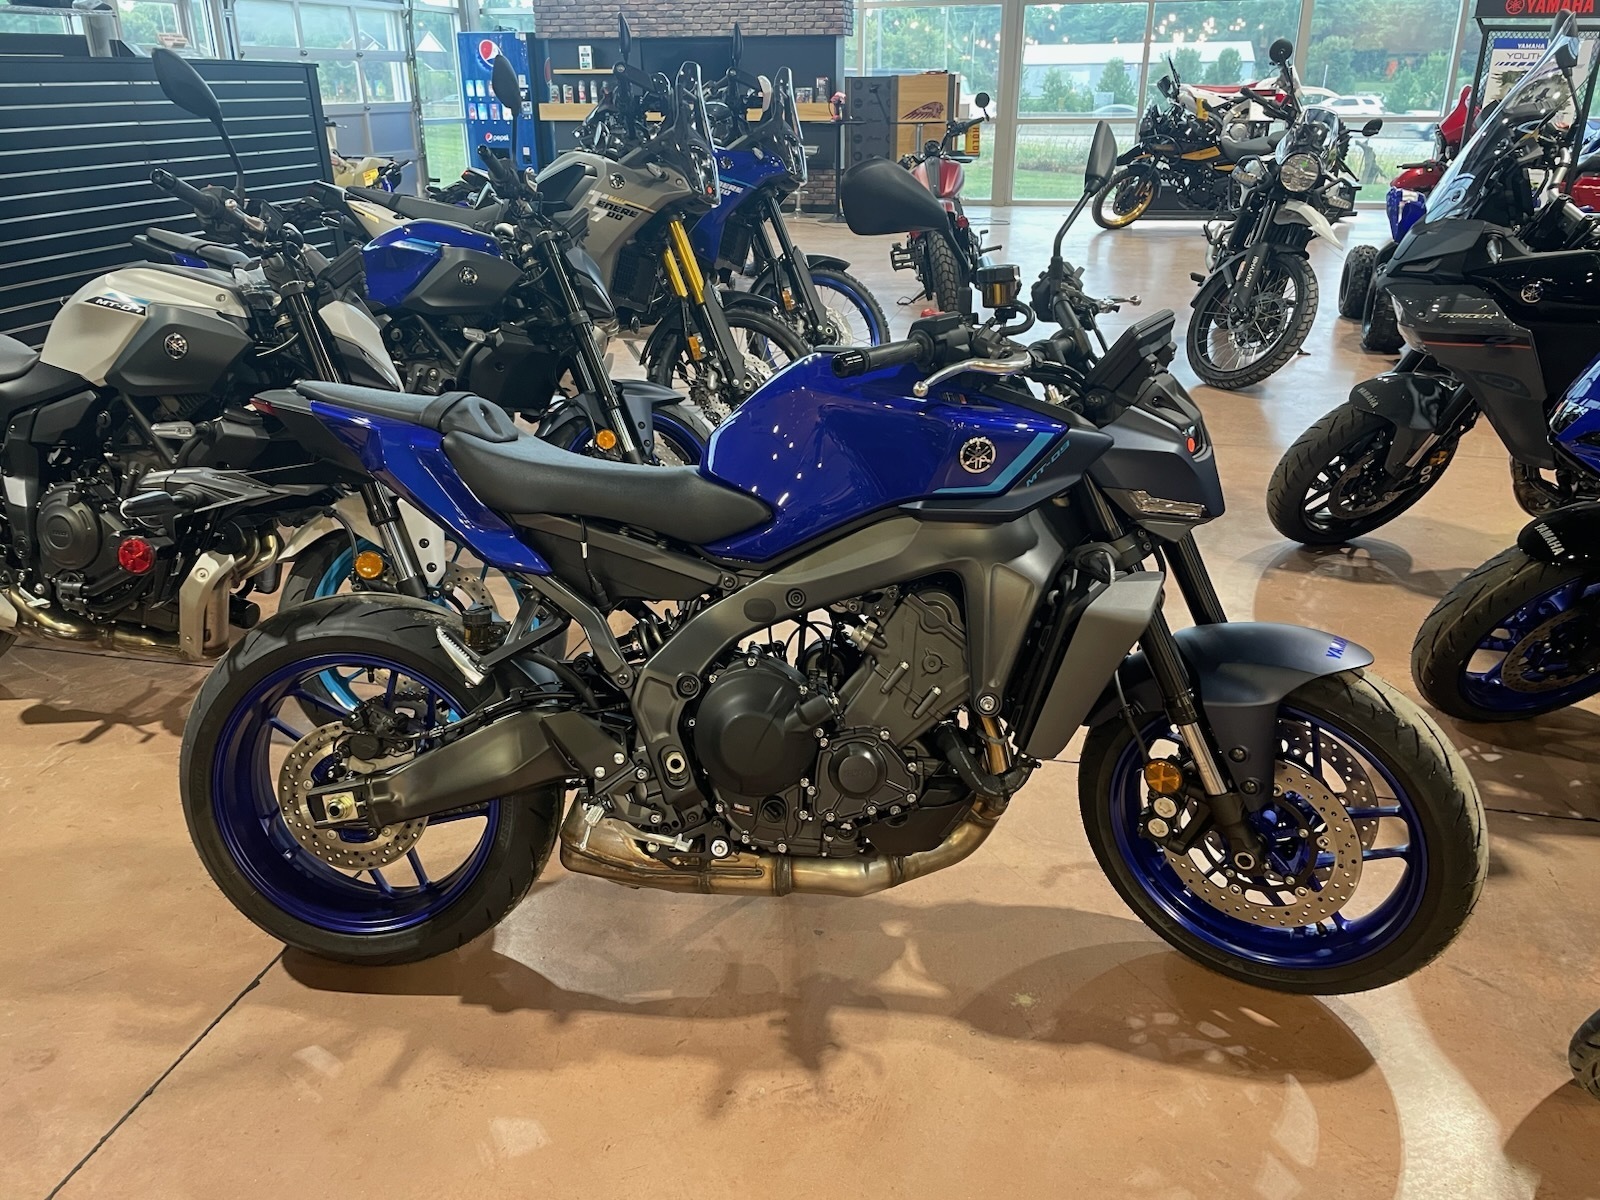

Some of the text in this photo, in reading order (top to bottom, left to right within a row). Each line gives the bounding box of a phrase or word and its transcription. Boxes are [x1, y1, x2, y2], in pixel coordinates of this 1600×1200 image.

[1527, 0, 1594, 13] YAMAHA
[492, 134, 510, 142] pepsi
[1243, 255, 1259, 288] HIMALAYAN
[96, 297, 145, 314] MT-07
[1026, 440, 1070, 488] MT-09
[1534, 522, 1565, 556] YAMAHA
